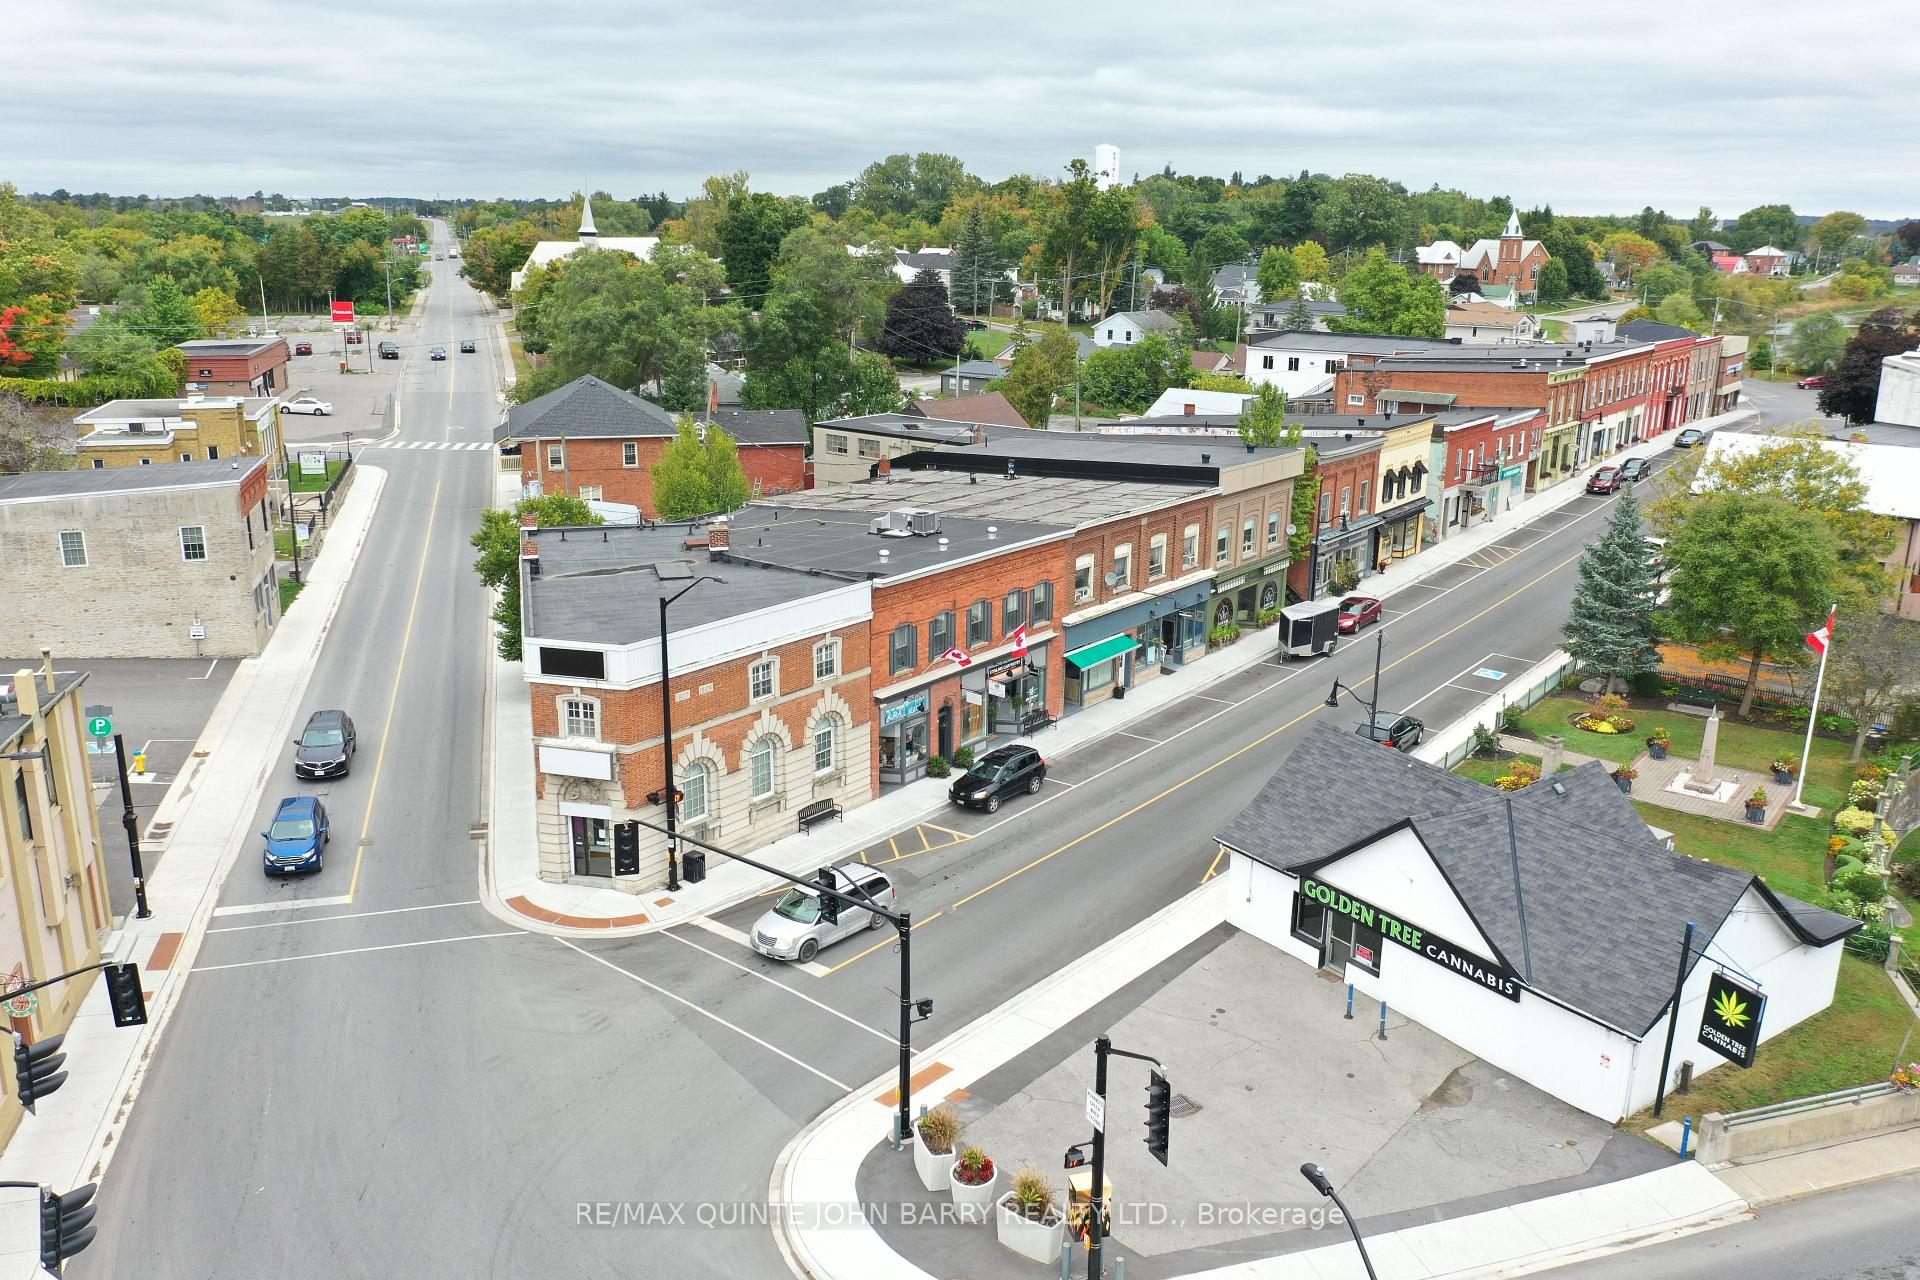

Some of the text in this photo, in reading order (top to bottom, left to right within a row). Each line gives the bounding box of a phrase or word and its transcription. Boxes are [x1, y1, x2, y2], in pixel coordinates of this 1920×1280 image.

[95, 719, 106, 731] P
[1304, 879, 1423, 950] GOLDEN TREE
[1426, 944, 1514, 995] CANNABIS
[1702, 1030, 1746, 1059] CANNABIS
[1703, 1024, 1747, 1052] GOLDEN TREE
